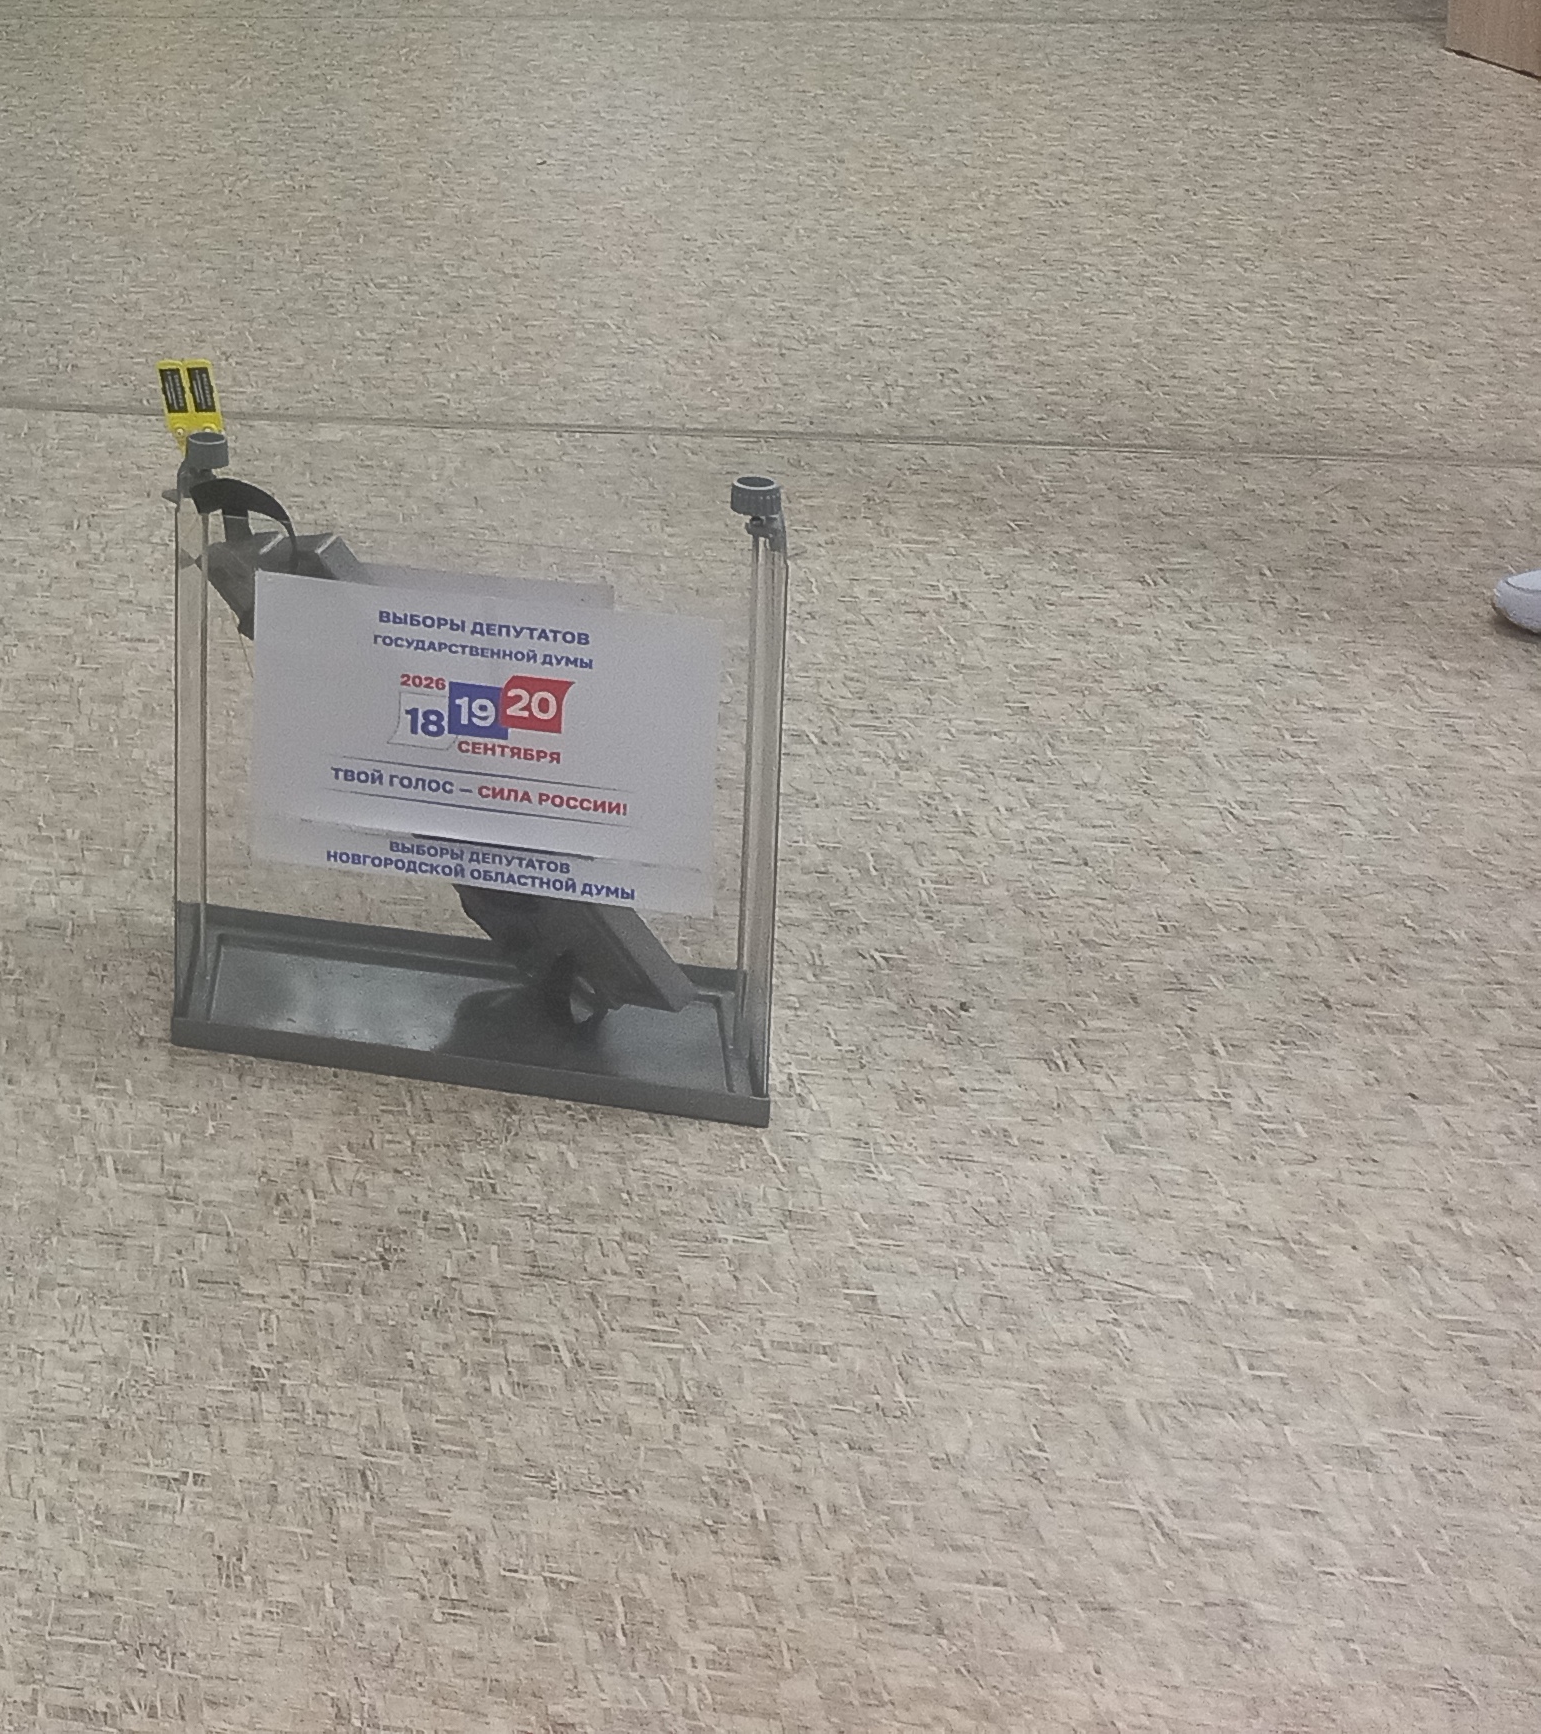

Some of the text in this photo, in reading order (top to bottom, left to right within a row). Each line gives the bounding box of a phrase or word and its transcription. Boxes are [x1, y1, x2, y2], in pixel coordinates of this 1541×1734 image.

[378, 610, 590, 645] ВЫБОРЫ ДЕПУТАТОВ
[373, 634, 593, 670] ГОСУДАРСТВЕННОЙ ДУМЫ
[400, 673, 446, 691] 2026
[455, 697, 496, 727] 19
[506, 688, 558, 720] 20
[405, 707, 445, 737] 18
[457, 740, 562, 765] СЕНТЯБРЯ
[331, 767, 384, 786] ТВОЙ
[388, 774, 455, 795] ГОЛОС
[477, 785, 533, 804] СИЛА
[538, 792, 628, 816] РОССИИ!
[389, 840, 571, 874] ВЫБОРЫ ДЕПУТАТОВ
[326, 850, 635, 901] НОВГОРОДСКОЙ ОБЛАСТНОЙ ДУМЫ
